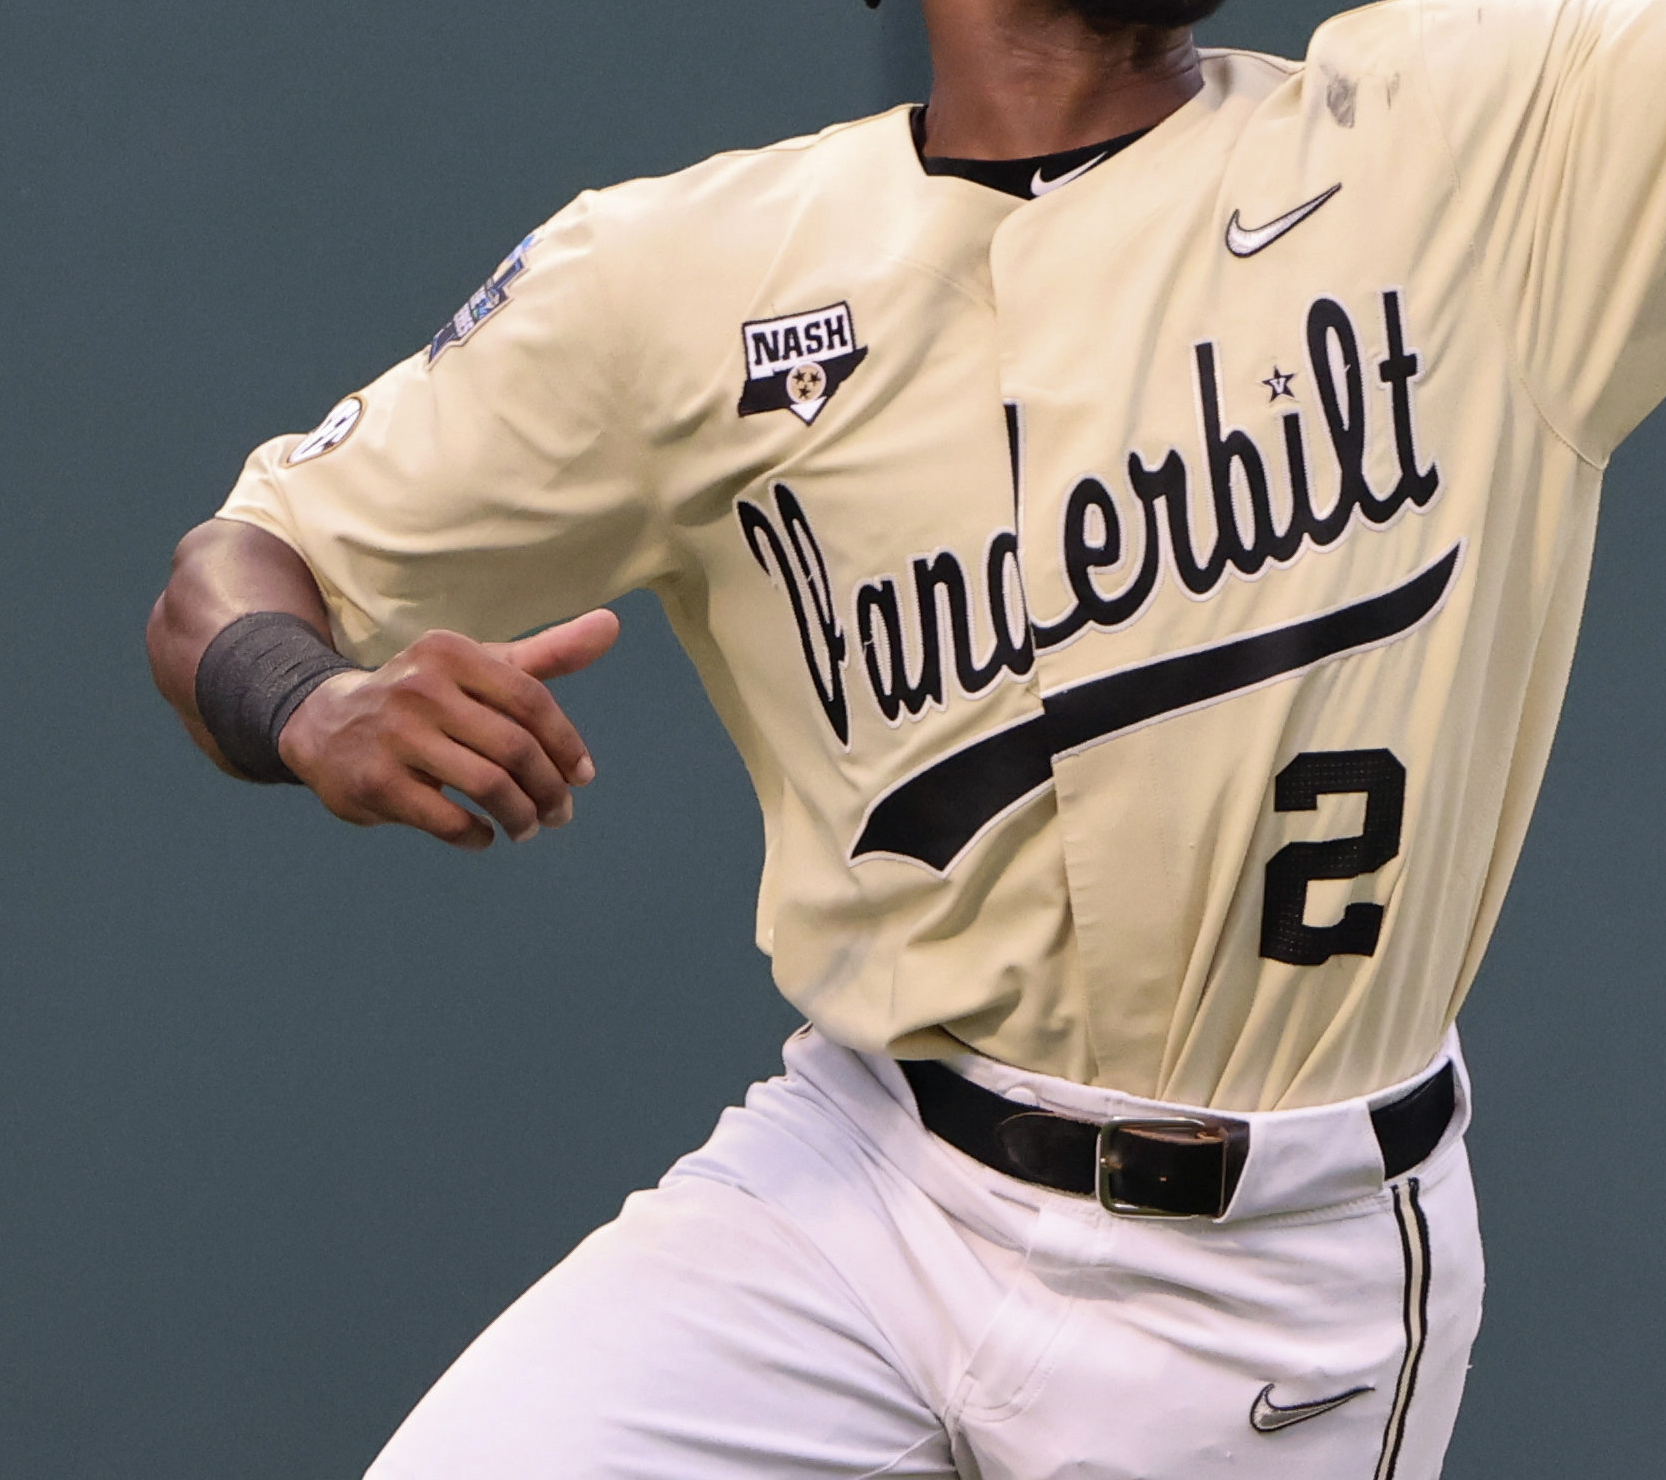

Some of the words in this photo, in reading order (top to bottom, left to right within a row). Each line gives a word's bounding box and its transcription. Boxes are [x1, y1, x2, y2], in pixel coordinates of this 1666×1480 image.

[751, 314, 848, 366] NASH
[735, 288, 1441, 753] Vanderbilt
[1260, 748, 1407, 966] 2
